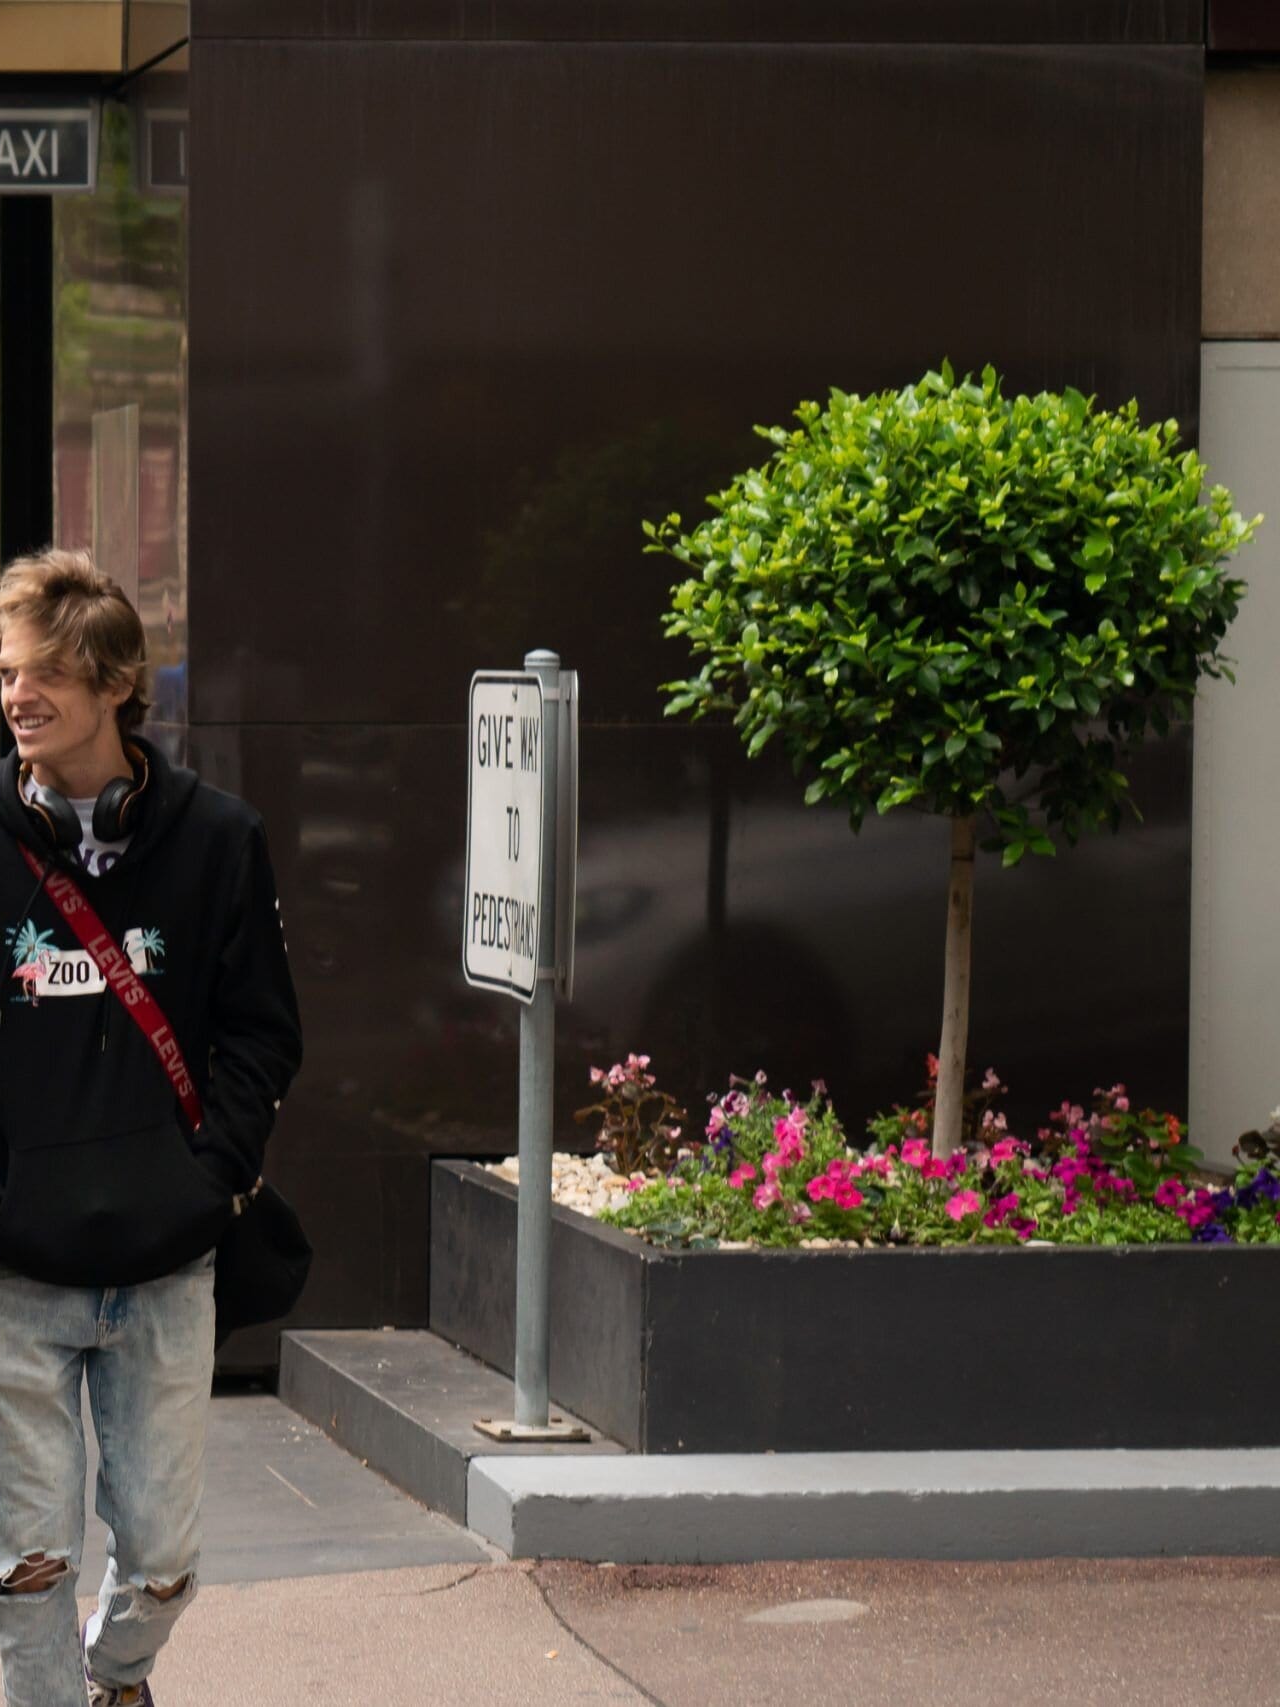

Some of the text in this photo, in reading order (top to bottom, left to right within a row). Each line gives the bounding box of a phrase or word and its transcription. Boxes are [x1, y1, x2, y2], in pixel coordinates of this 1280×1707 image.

[477, 713, 539, 773] GIVE WAY
[506, 807, 520, 862] TO
[472, 892, 535, 960] PEDESTRIANS
[48, 960, 90, 985] ZOO
